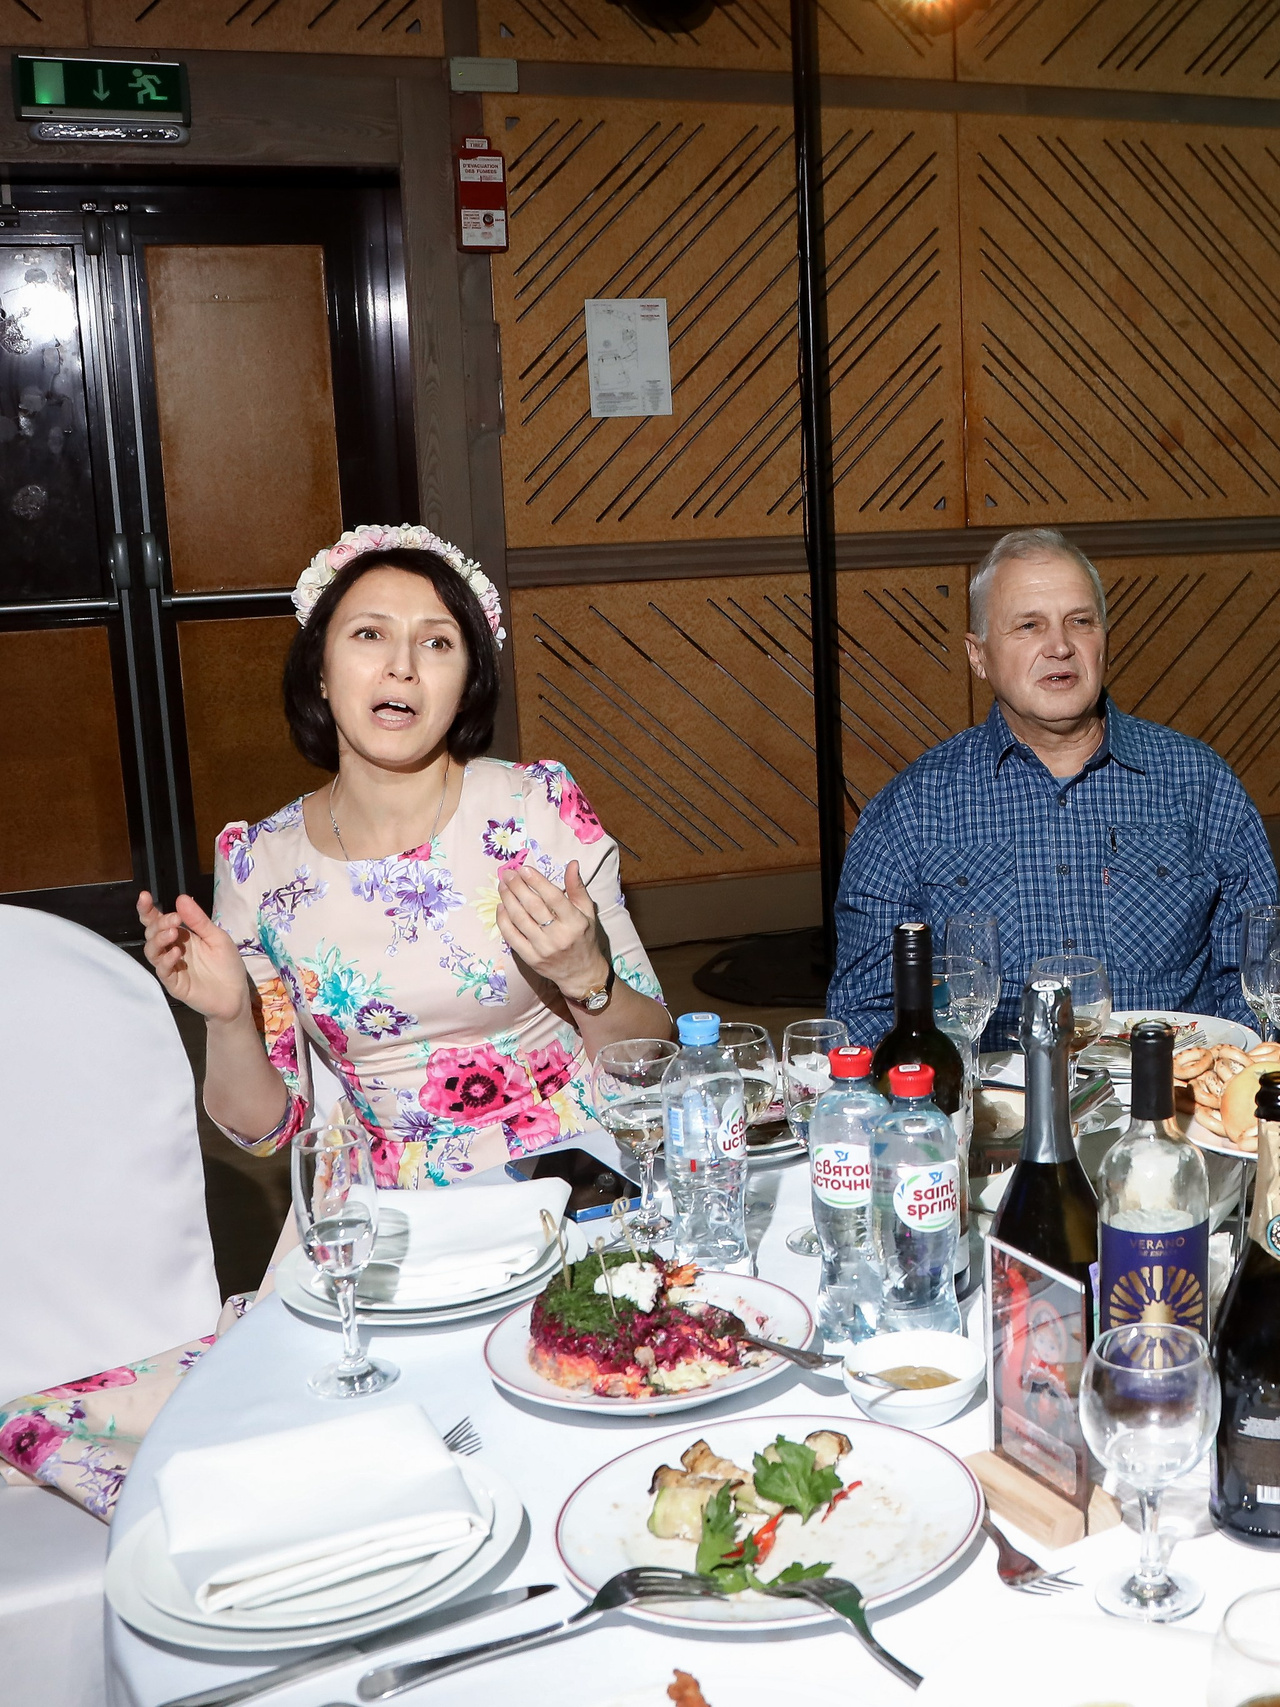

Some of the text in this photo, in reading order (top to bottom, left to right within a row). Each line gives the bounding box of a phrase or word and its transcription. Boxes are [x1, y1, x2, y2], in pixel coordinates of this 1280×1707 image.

[913, 1179, 954, 1201] saint
[907, 1194, 957, 1221] spring
[1129, 1236, 1186, 1250] VERANO
